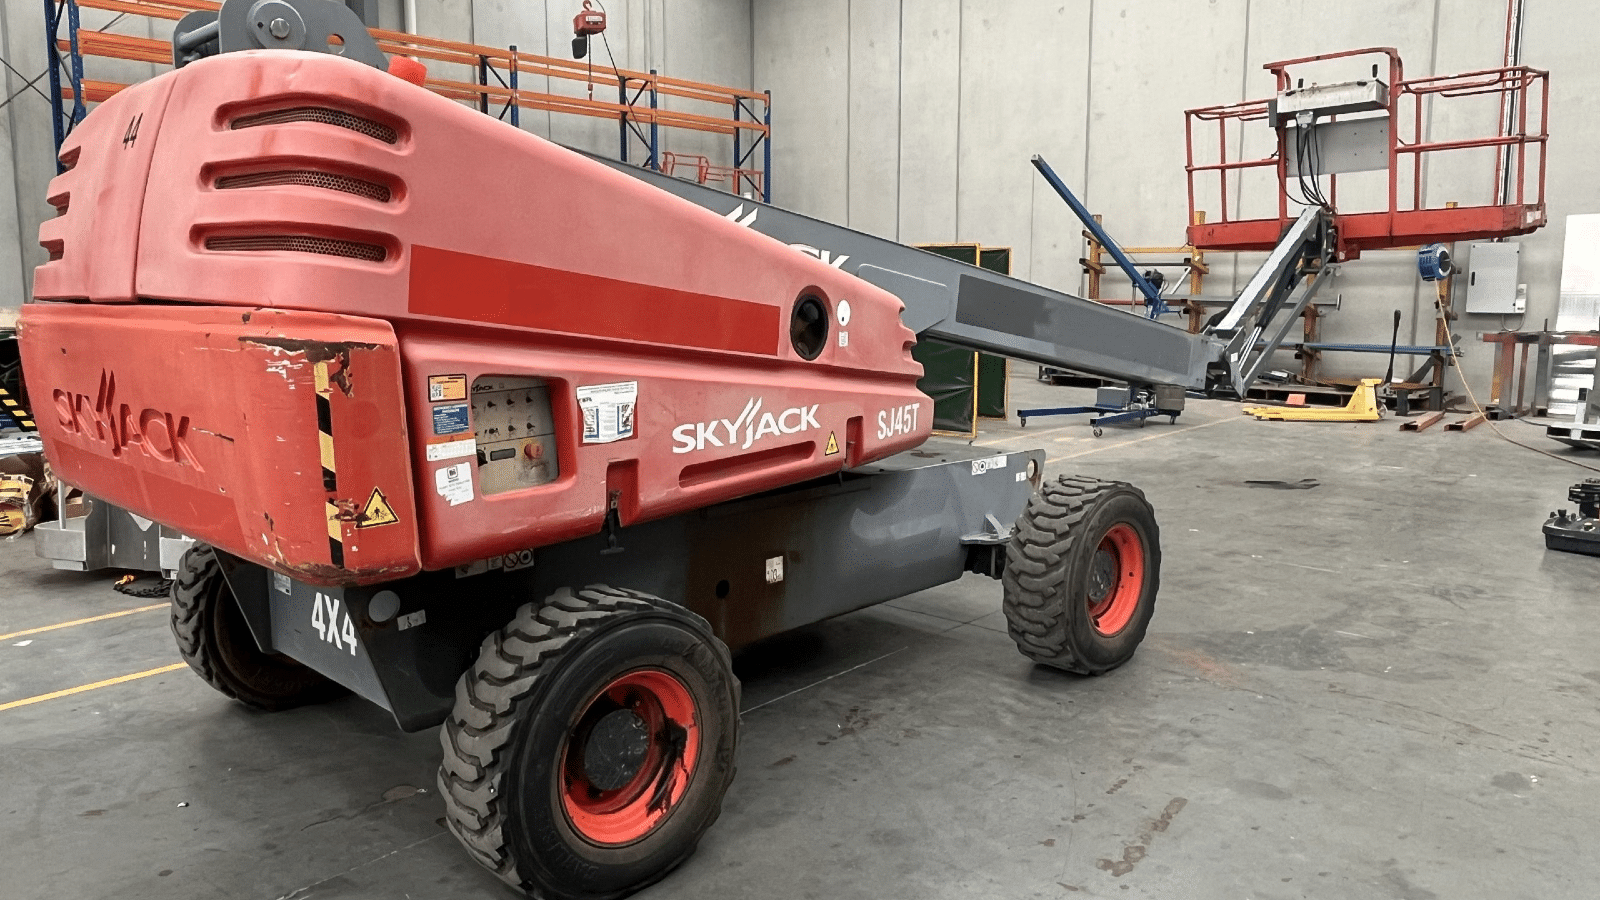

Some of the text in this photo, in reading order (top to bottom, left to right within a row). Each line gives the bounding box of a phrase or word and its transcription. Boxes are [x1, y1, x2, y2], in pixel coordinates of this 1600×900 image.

[123, 112, 143, 150] 44
[53, 367, 205, 472] SKYJACK
[672, 396, 821, 453] SKYJACK
[877, 403, 920, 440] SJ45T
[311, 591, 358, 657] 4X4
